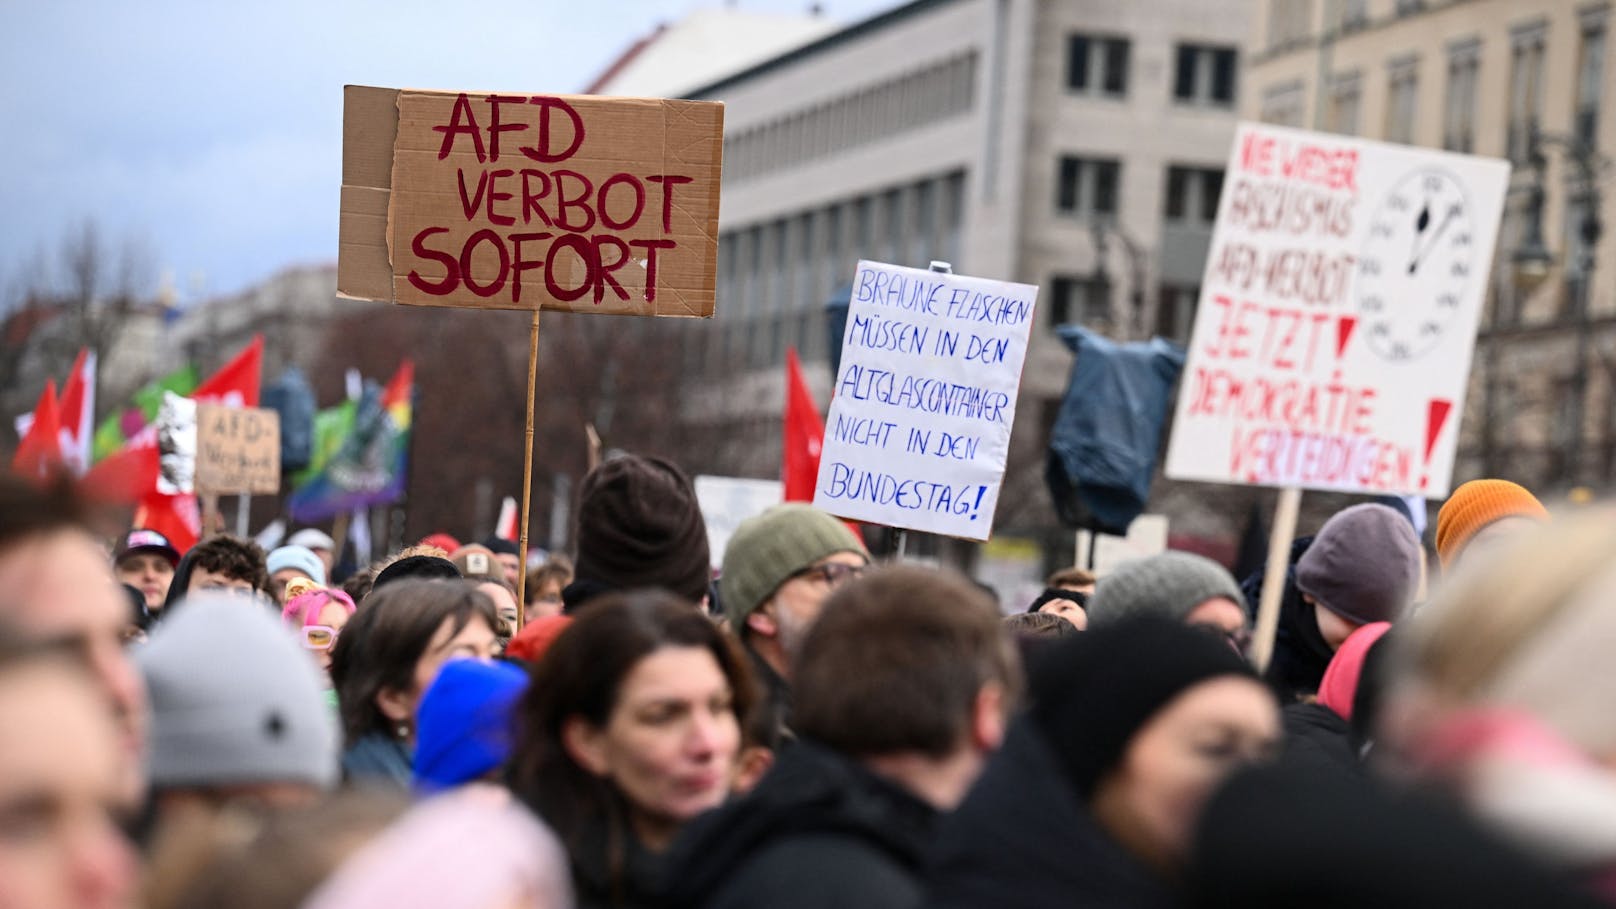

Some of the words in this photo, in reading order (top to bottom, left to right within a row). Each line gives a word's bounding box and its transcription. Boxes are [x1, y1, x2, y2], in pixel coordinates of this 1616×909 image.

[432, 93, 585, 164] AFD
[458, 168, 694, 234] VERBOT
[407, 227, 677, 304] SOFORT
[857, 269, 945, 316] BRAUNE
[947, 288, 1030, 326] FLASCHEN
[849, 314, 928, 355] MÜSSEN
[935, 330, 959, 357] IN
[965, 335, 1009, 363] DEN
[840, 364, 1008, 422] ALTGLASCONTAINER
[835, 413, 897, 448] NICHT
[907, 428, 931, 455] IN
[934, 432, 981, 460] DEN
[824, 463, 987, 520] BUNDESTAG!
